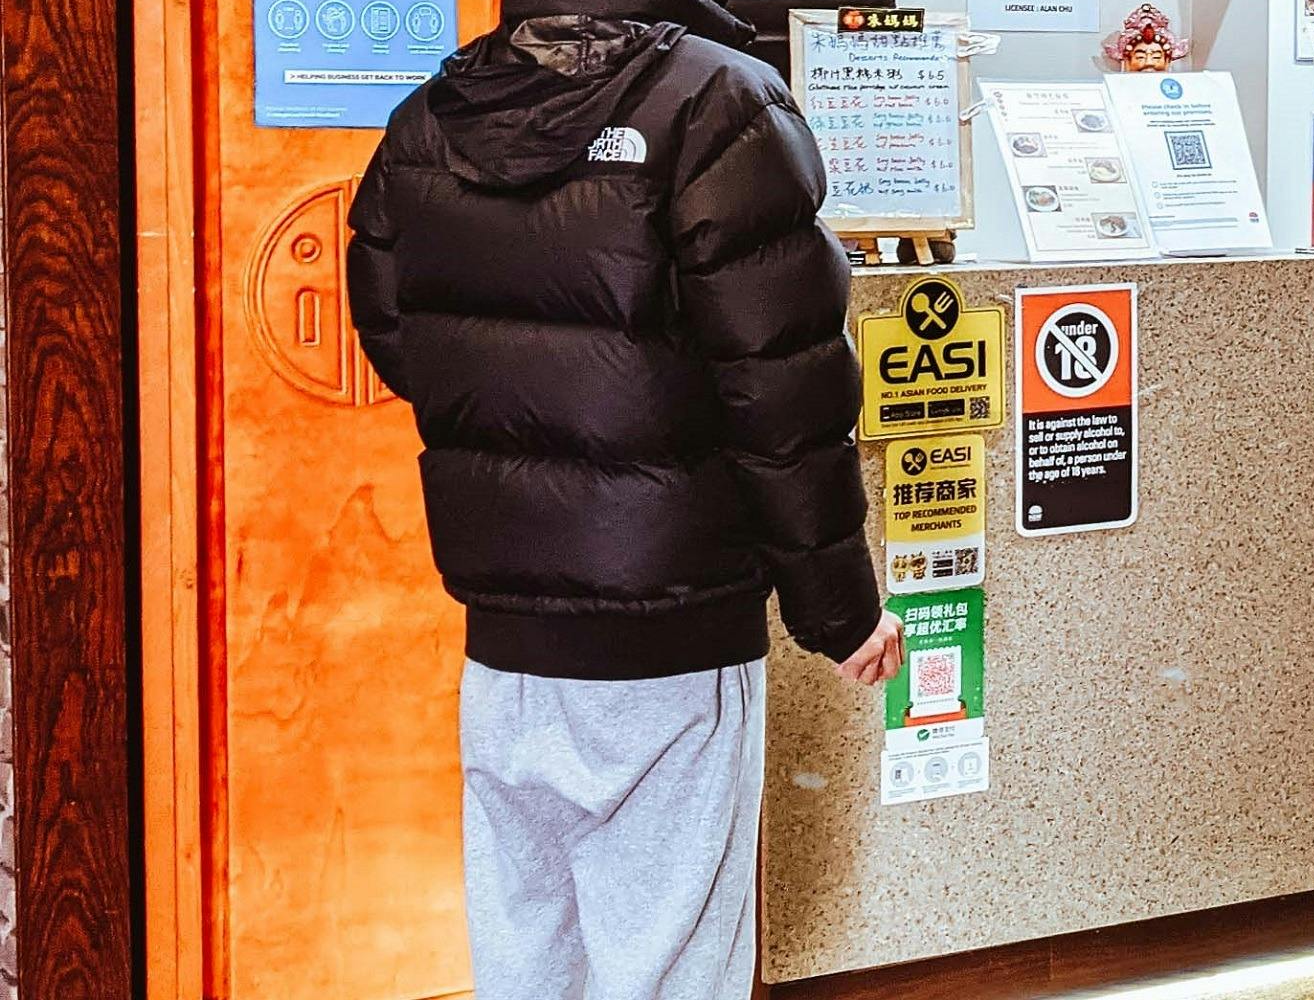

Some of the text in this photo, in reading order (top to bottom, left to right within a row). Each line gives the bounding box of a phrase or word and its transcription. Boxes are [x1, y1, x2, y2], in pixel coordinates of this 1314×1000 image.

[1005, 4, 1035, 12] LICENSEE
[1040, 5, 1057, 13] ALAN
[601, 127, 625, 138] THE
[587, 149, 622, 161] FACE
[1061, 320, 1099, 336] under
[879, 340, 987, 384] EASI
[1054, 336, 1098, 380] 18
[881, 384, 987, 399] NO.1 ASIAN FOOD DELIVERY
[1028, 414, 1118, 431] It is against the law to
[1028, 426, 1125, 443] sell or supply alcohol to,
[930, 446, 971, 464] EASI
[1028, 438, 1118, 456] or to obtain alcohol on
[1028, 450, 1127, 468] behalf of, a person under
[1028, 465, 1106, 481] the age of 18 years.
[893, 477, 977, 506] 推荐商家
[894, 505, 977, 521] TOP RECOMMENDED
[911, 519, 962, 532] MERCHANTS
[905, 602, 968, 622] 扫码领礼包
[904, 617, 967, 638] 享超优汇率
